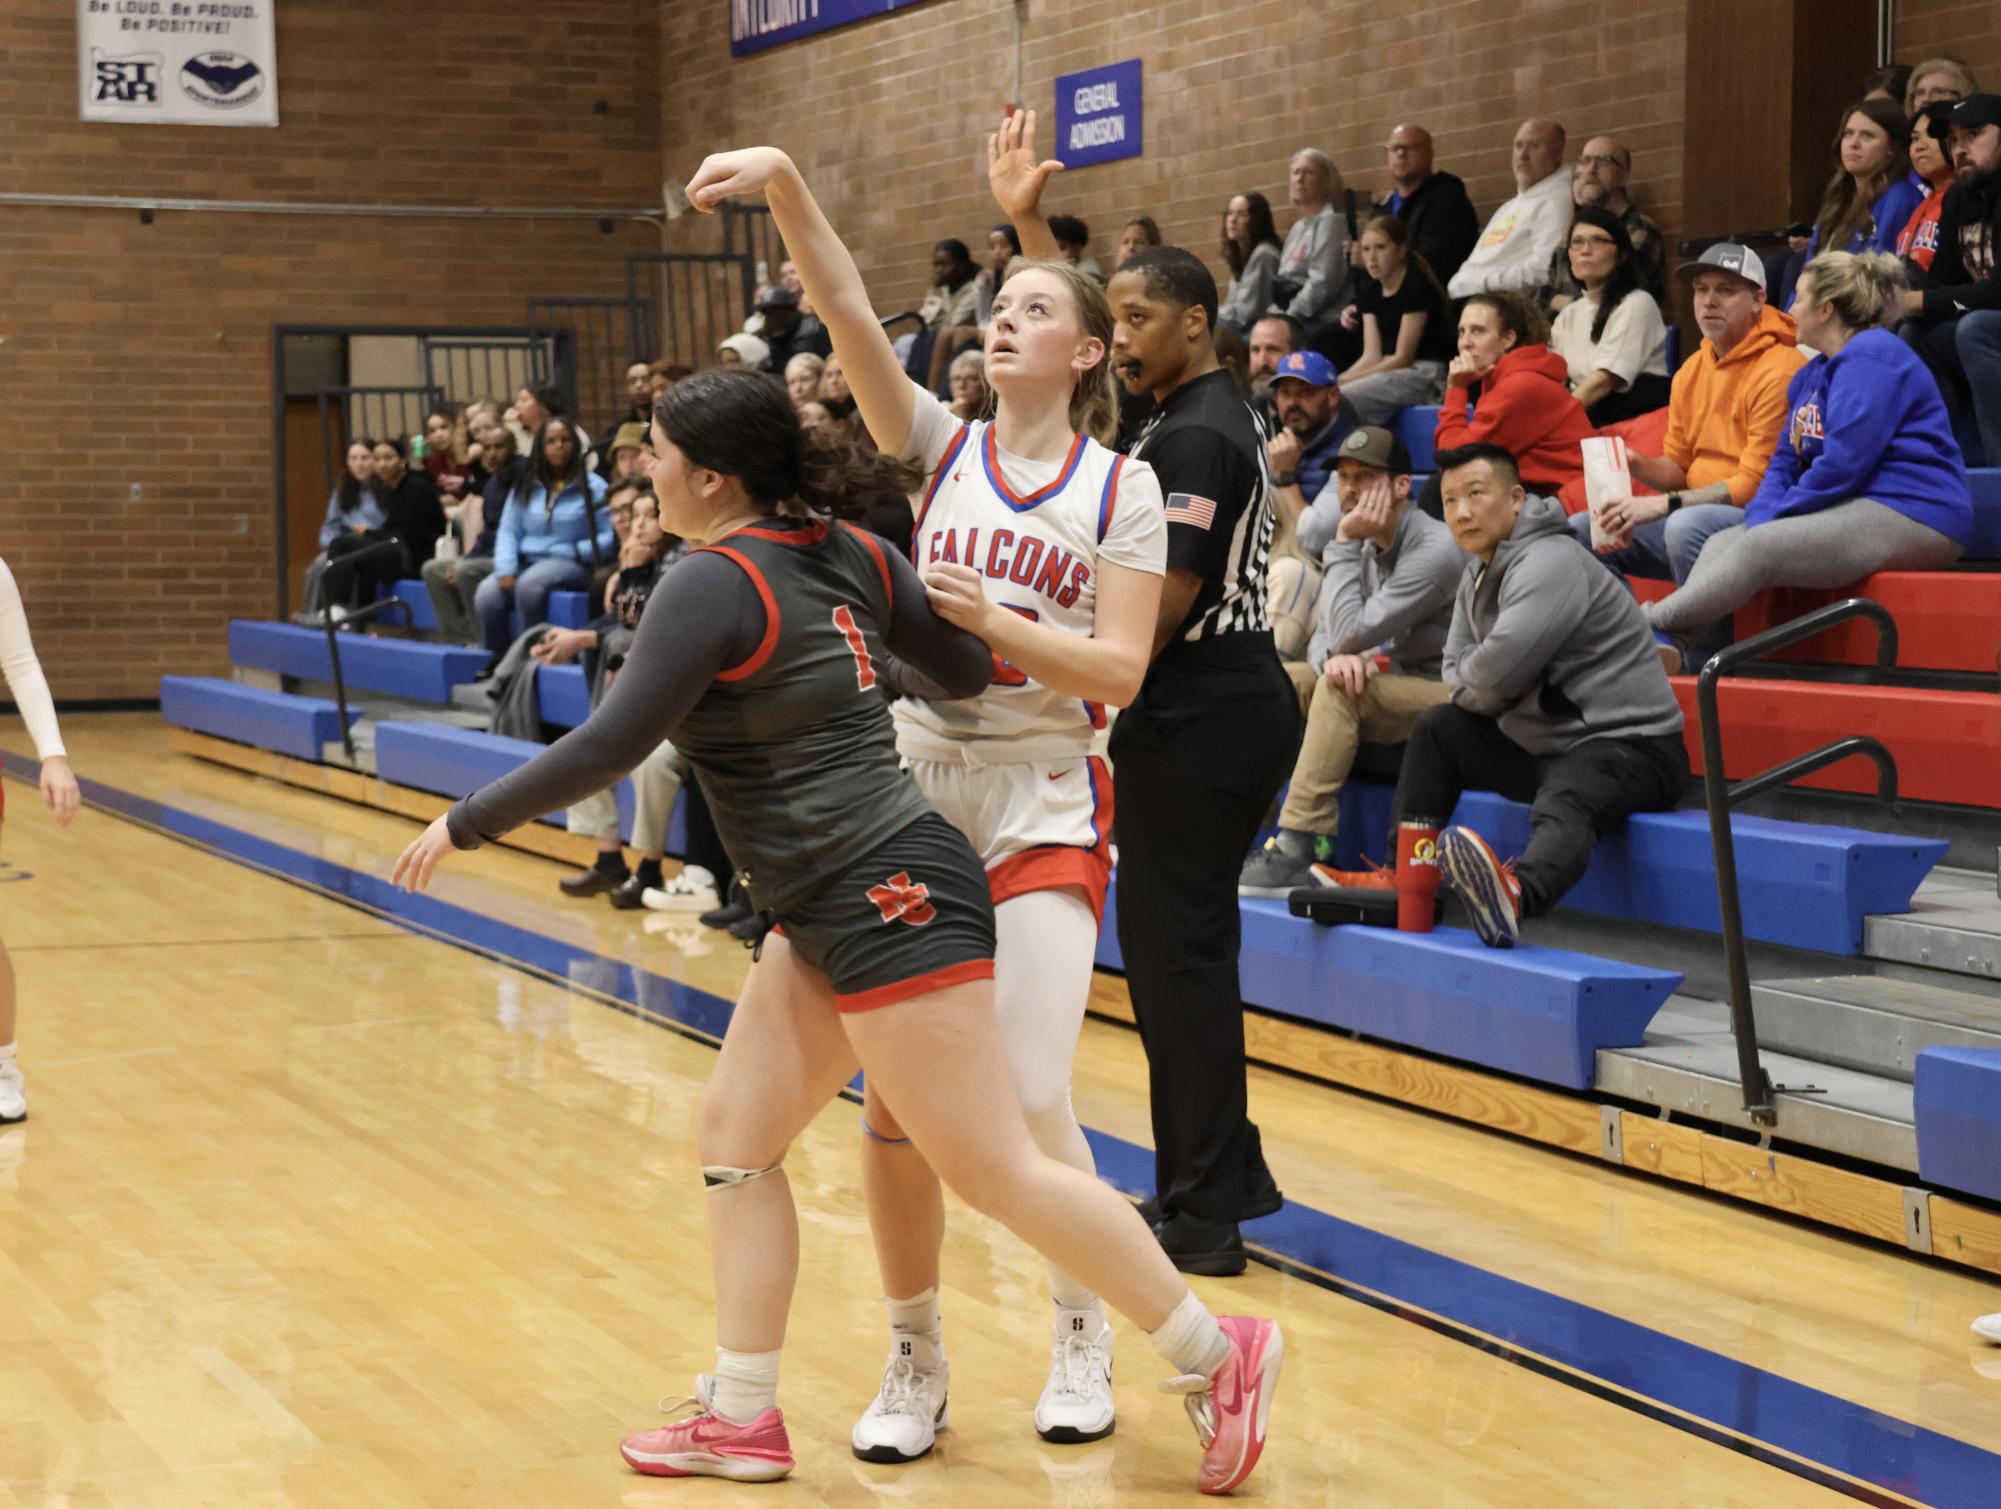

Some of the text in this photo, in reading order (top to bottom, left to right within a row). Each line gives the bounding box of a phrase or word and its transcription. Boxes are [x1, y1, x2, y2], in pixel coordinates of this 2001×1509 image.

[89, 1, 110, 12] Be
[171, 3, 192, 16] Be
[121, 18, 141, 31] Be
[1074, 82, 1120, 115] GENERAL
[930, 528, 1090, 608] FALCONS
[832, 604, 876, 692] 1
